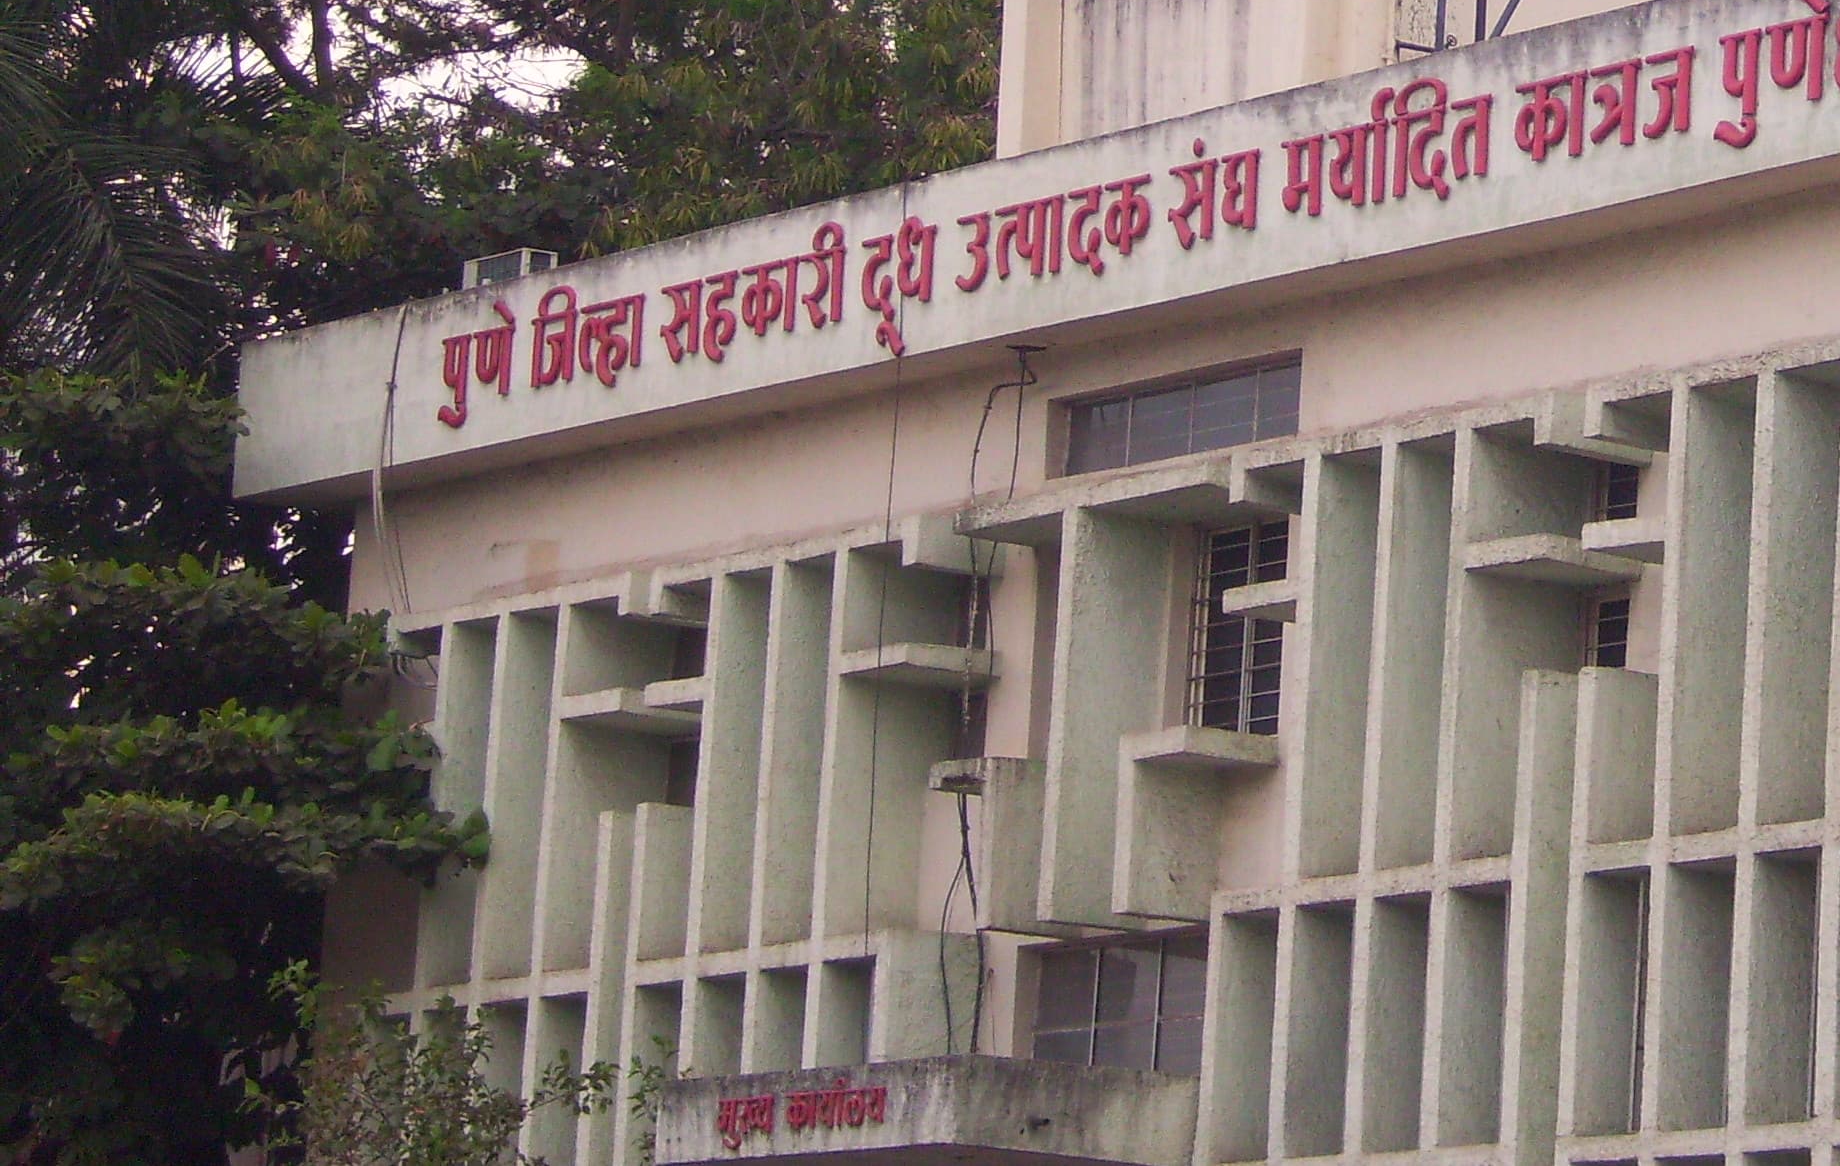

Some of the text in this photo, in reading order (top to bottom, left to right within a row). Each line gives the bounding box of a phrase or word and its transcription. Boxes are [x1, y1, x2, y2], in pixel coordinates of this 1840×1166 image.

[437, 301, 516, 428] पुणे
[531, 285, 645, 388] जिल्हा
[660, 221, 848, 363] सहकारी
[861, 215, 938, 357] दूध
[955, 173, 1152, 292] उत्पादक
[1167, 137, 1262, 250] संघ
[1281, 77, 1494, 216] मर्यादित
[1514, 44, 1696, 163] कात्रज
[717, 1078, 887, 1150] मुख्य कार्यालय
